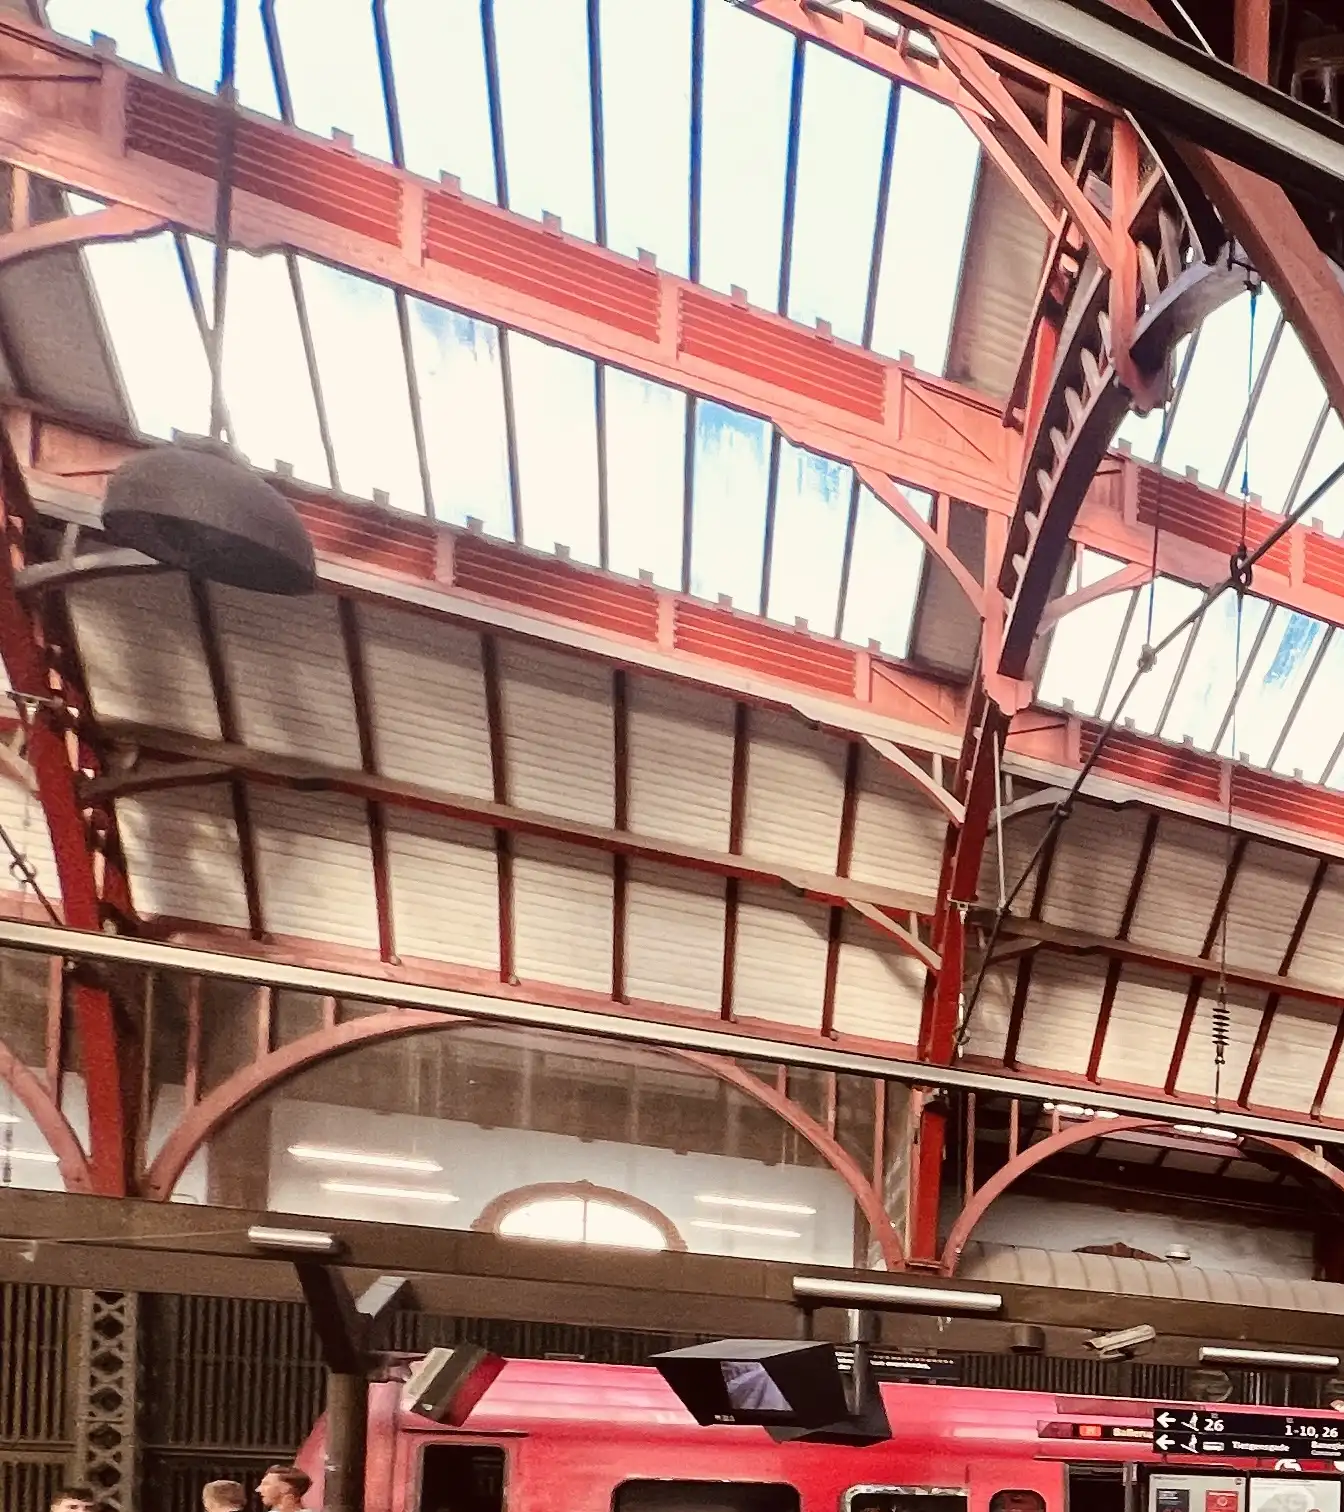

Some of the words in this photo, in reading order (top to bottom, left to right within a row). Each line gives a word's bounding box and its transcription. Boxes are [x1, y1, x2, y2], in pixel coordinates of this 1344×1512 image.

[1203, 1418, 1224, 1432] 26
[1285, 1424, 1319, 1439] 1-10,
[1322, 1427, 1339, 1438] 26
